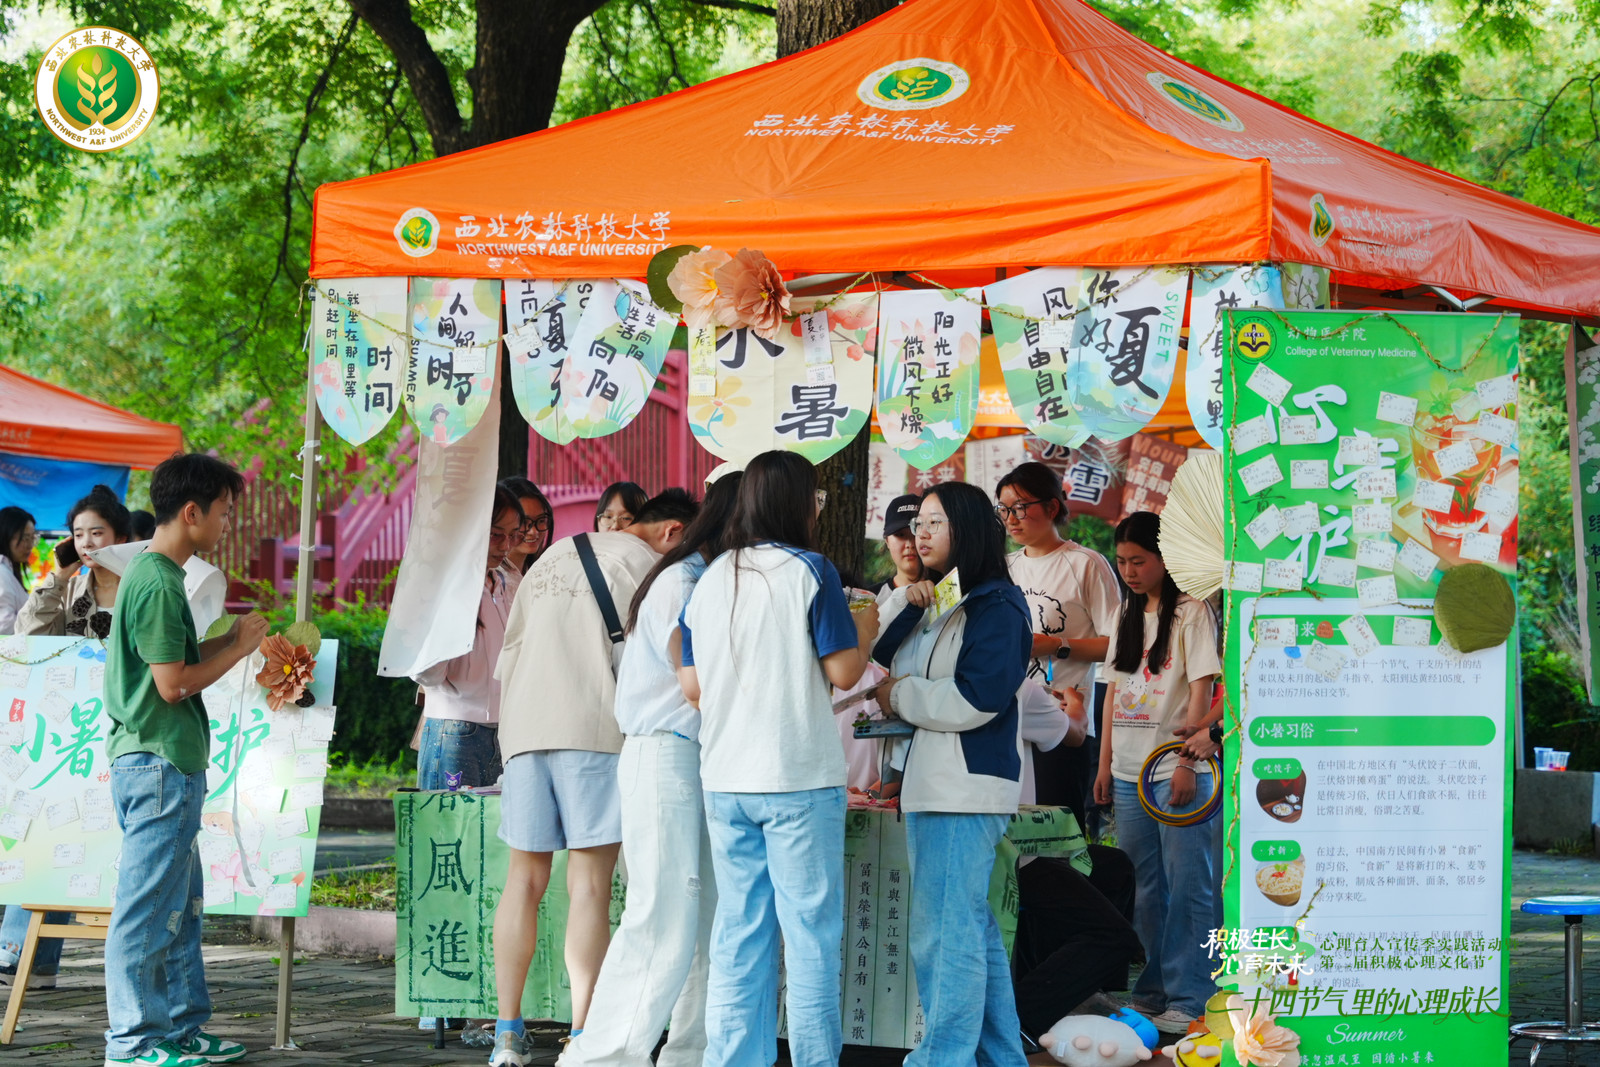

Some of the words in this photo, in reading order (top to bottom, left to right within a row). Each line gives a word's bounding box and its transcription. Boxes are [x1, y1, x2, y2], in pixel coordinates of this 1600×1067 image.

[744, 129, 853, 138] NORTHWEST
[853, 130, 892, 139] A&F
[893, 132, 1003, 145] UNIVERSITY
[753, 111, 1016, 139] 西北农林科技大学
[455, 211, 671, 241] 西北农林科技大学
[455, 243, 546, 256] NORTHWEST
[548, 243, 575, 256] A&F
[579, 242, 671, 256] UNIVERSITY
[326, 288, 340, 359] 别赶时间
[344, 291, 360, 399] 就坐在那里等
[1079, 270, 1120, 355] 你好
[1154, 290, 1179, 363] SWEET
[1287, 326, 1367, 342] 动物医学院
[364, 345, 394, 414] 时间
[406, 339, 420, 403] SUMMER
[586, 335, 620, 402] 向阳
[900, 335, 925, 434] 微风不燥
[931, 311, 955, 404] 阳光正好
[1023, 319, 1069, 423] 自由自在
[1106, 306, 1162, 400] 夏
[1285, 346, 1318, 358] College
[1319, 346, 1329, 356] of
[1331, 346, 1376, 358] Veterinary
[1377, 347, 1417, 358] Medicine
[10, 697, 104, 790] 小暑
[1255, 723, 1314, 738] 小暑习俗
[1326, 1023, 1407, 1045] Summer
